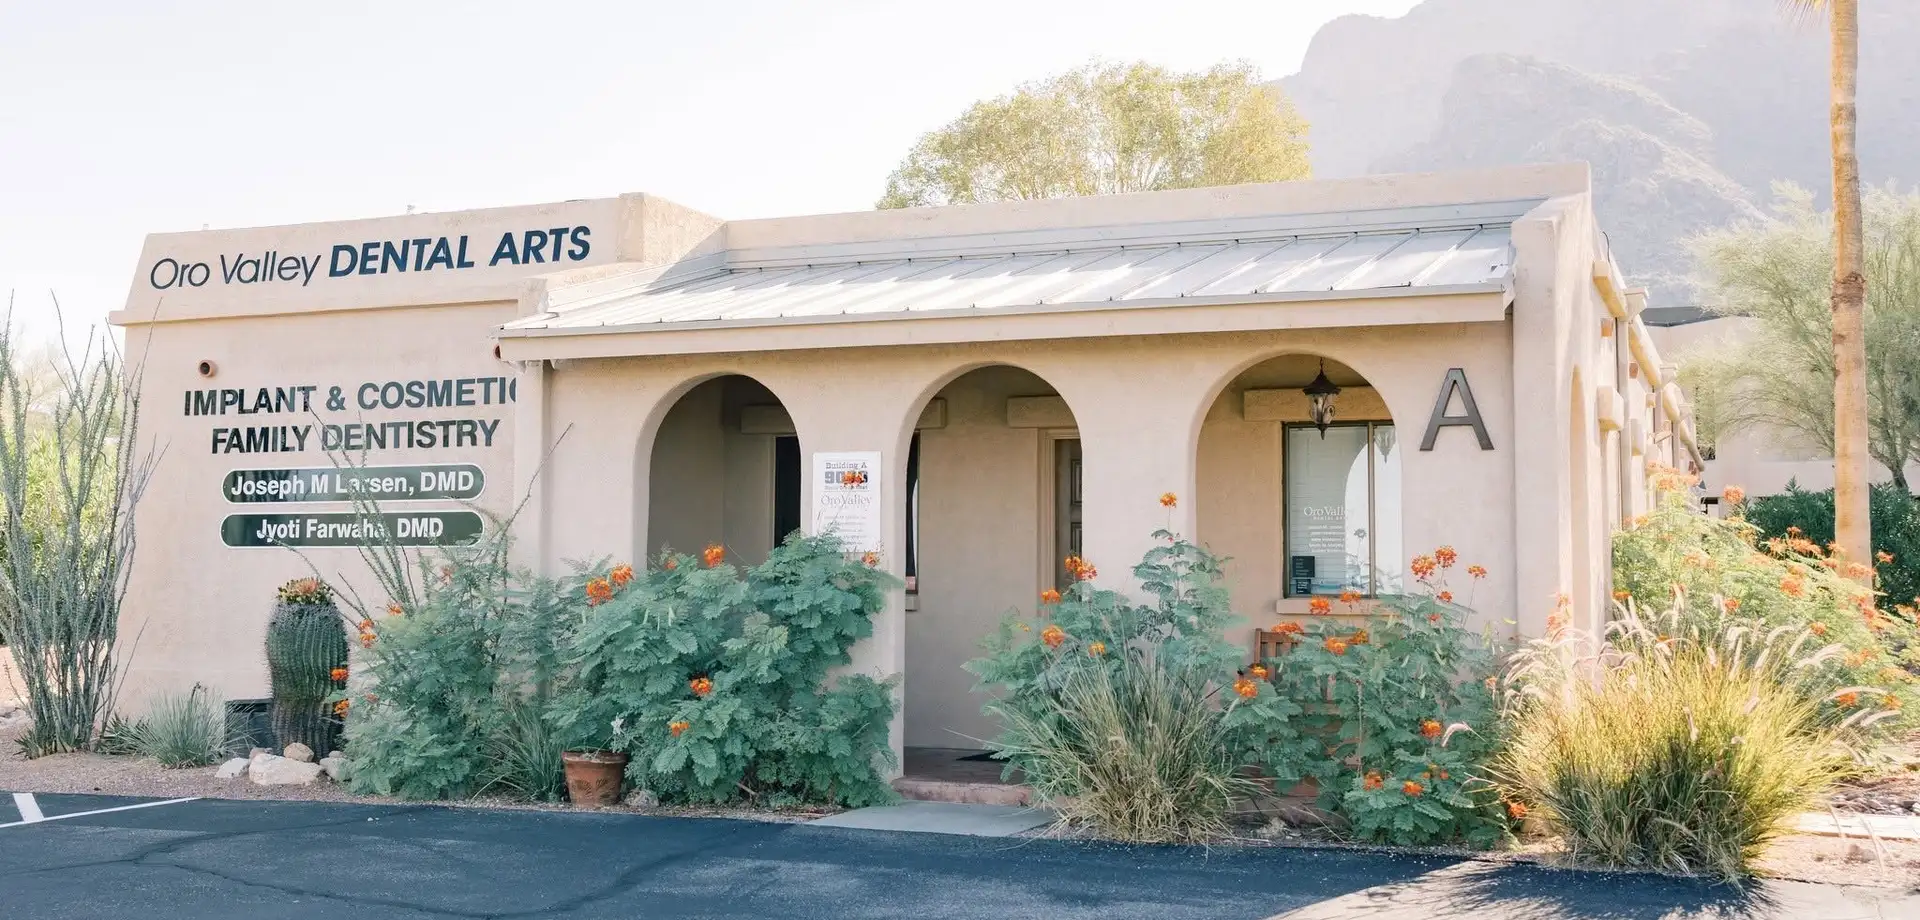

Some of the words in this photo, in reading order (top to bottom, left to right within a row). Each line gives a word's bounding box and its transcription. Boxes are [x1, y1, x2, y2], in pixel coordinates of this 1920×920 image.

[150, 257, 211, 290] Oro
[219, 249, 322, 286] Valley
[328, 234, 475, 278] DENTAL
[488, 225, 591, 267] ARTS
[184, 386, 317, 416] IMPLANT
[325, 385, 347, 412] &
[357, 376, 516, 410] COSMETI
[1419, 367, 1495, 451] A
[211, 424, 312, 454] FAMILY
[321, 418, 501, 451] DENTISTRY
[231, 475, 304, 499] Joseph
[310, 474, 329, 494] M
[334, 473, 415, 497] Larsen,
[420, 470, 475, 493] DMD
[256, 519, 300, 542] Jyoti
[396, 517, 444, 539] DMD
